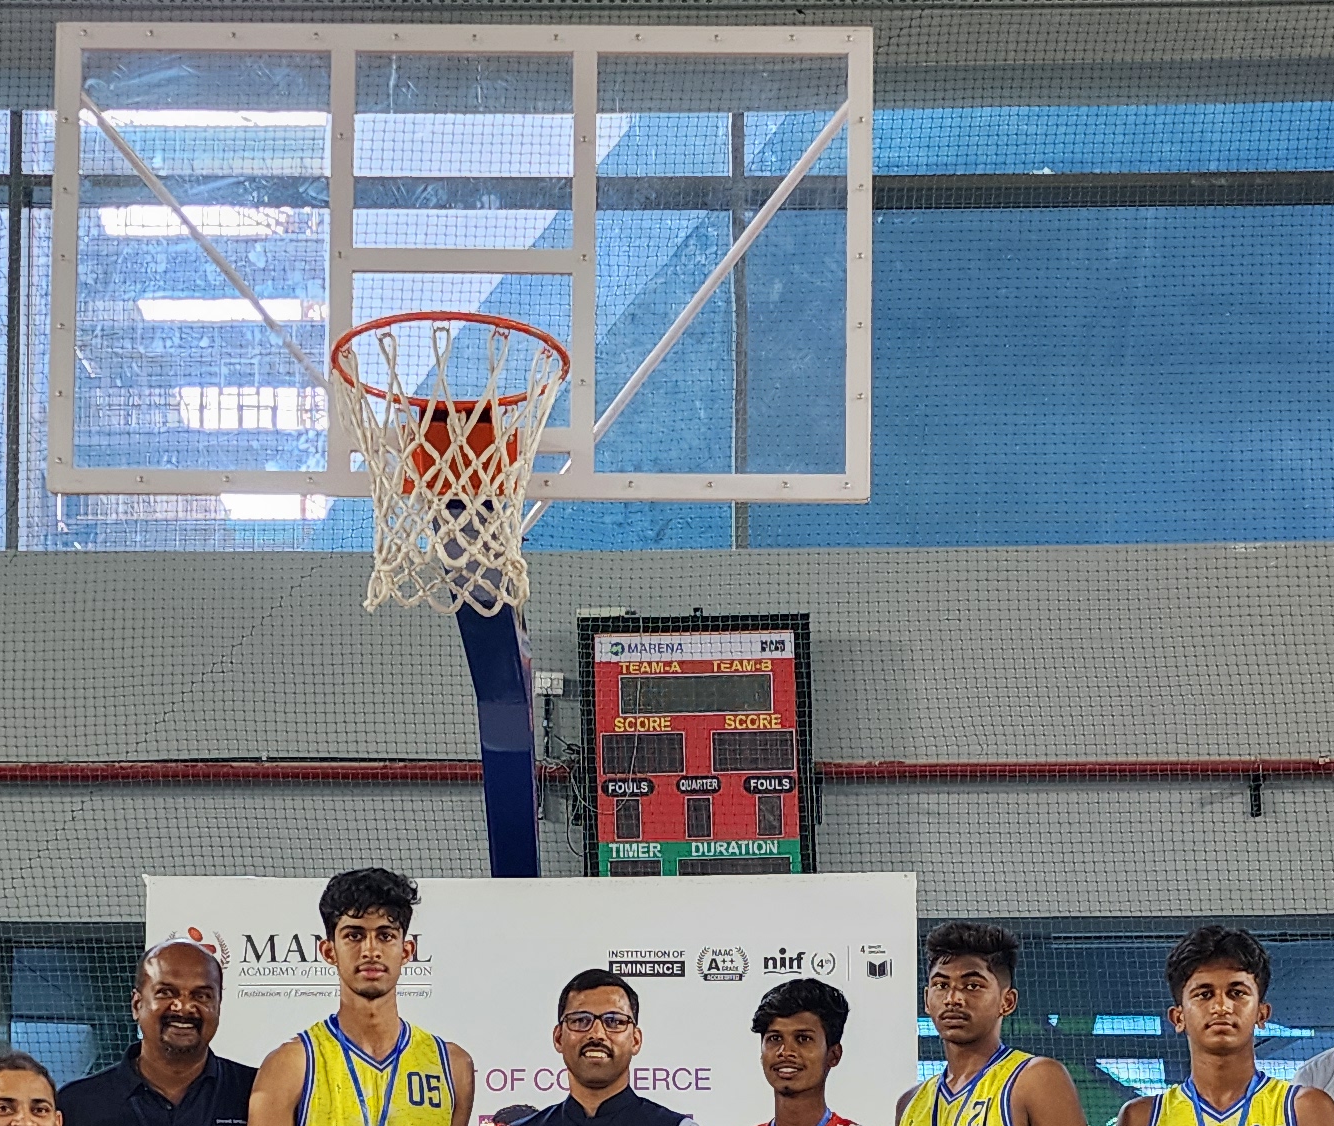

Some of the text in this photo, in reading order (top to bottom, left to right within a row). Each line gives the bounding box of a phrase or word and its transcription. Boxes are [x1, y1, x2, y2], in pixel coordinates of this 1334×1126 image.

[627, 642, 684, 654] MARENA
[619, 662, 682, 674] TEAM-A
[712, 660, 772, 672] TEAM-B
[614, 717, 671, 732] SCORE
[725, 715, 782, 729] SCORE
[608, 782, 649, 793] FOULS
[679, 779, 719, 791] QUARTER
[750, 779, 790, 790] FOULS
[609, 843, 662, 858] TIMER
[691, 841, 778, 856] DURATION
[608, 950, 685, 958] INSTITUTION OF
[712, 948, 734, 957] NAAC
[763, 947, 806, 970] nirf
[238, 965, 341, 978] ACADEMY of HIG
[612, 963, 682, 974] EMINENCE
[486, 1067, 713, 1092] OF COERCE
[406, 1071, 442, 1108] 05
